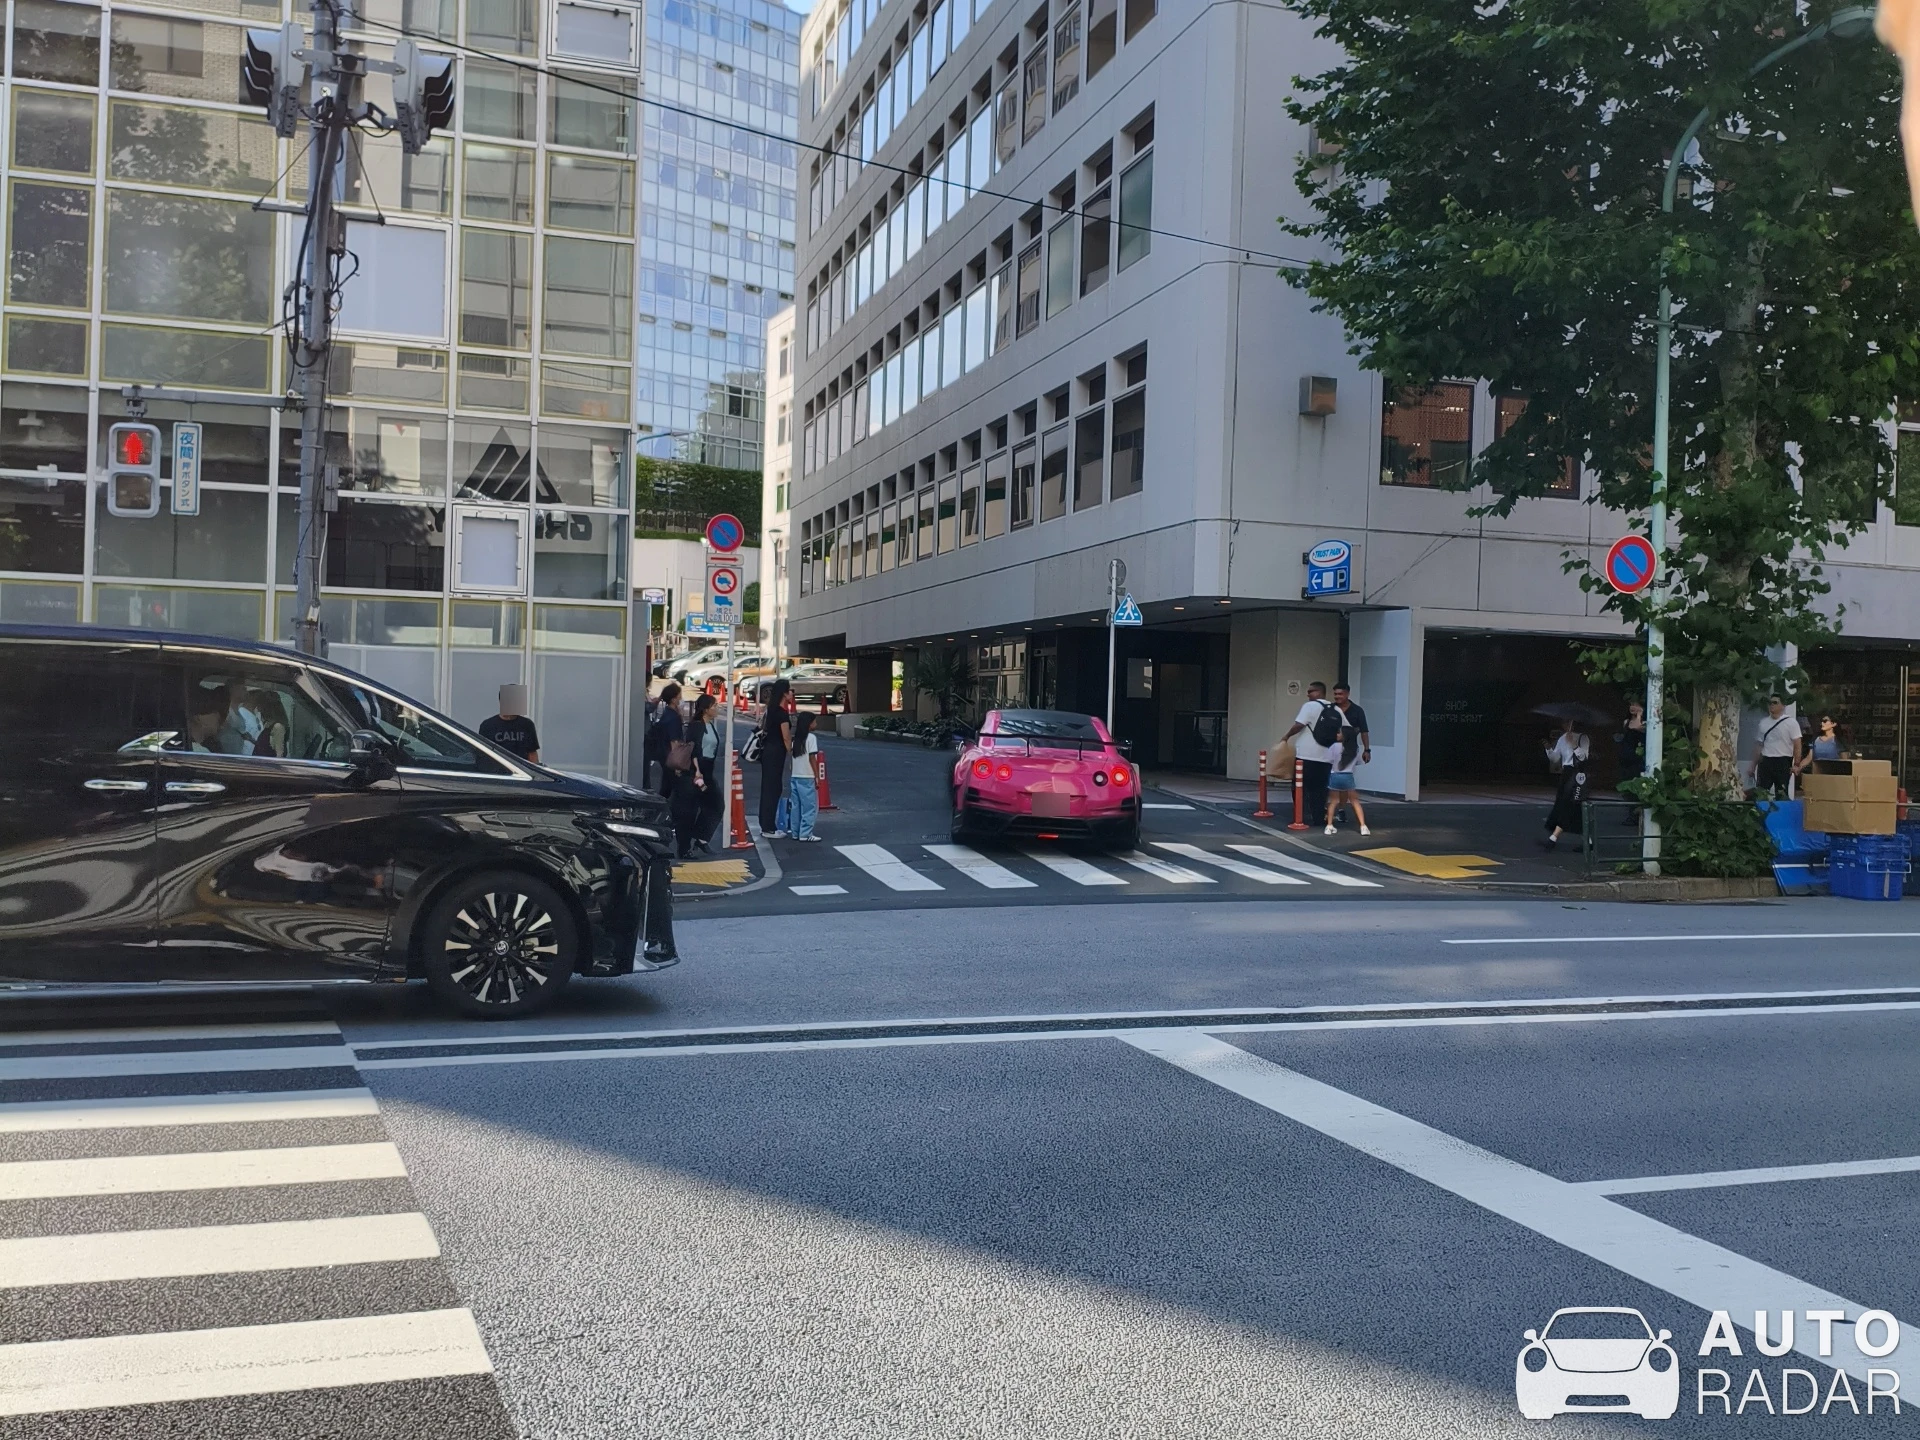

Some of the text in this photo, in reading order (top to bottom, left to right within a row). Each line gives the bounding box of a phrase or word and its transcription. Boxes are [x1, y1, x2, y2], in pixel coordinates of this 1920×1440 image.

[1315, 547, 1343, 558] TRUST PARK
[1337, 569, 1346, 588] P
[1445, 700, 1468, 711] SHOP
[495, 731, 525, 742] CALIF
